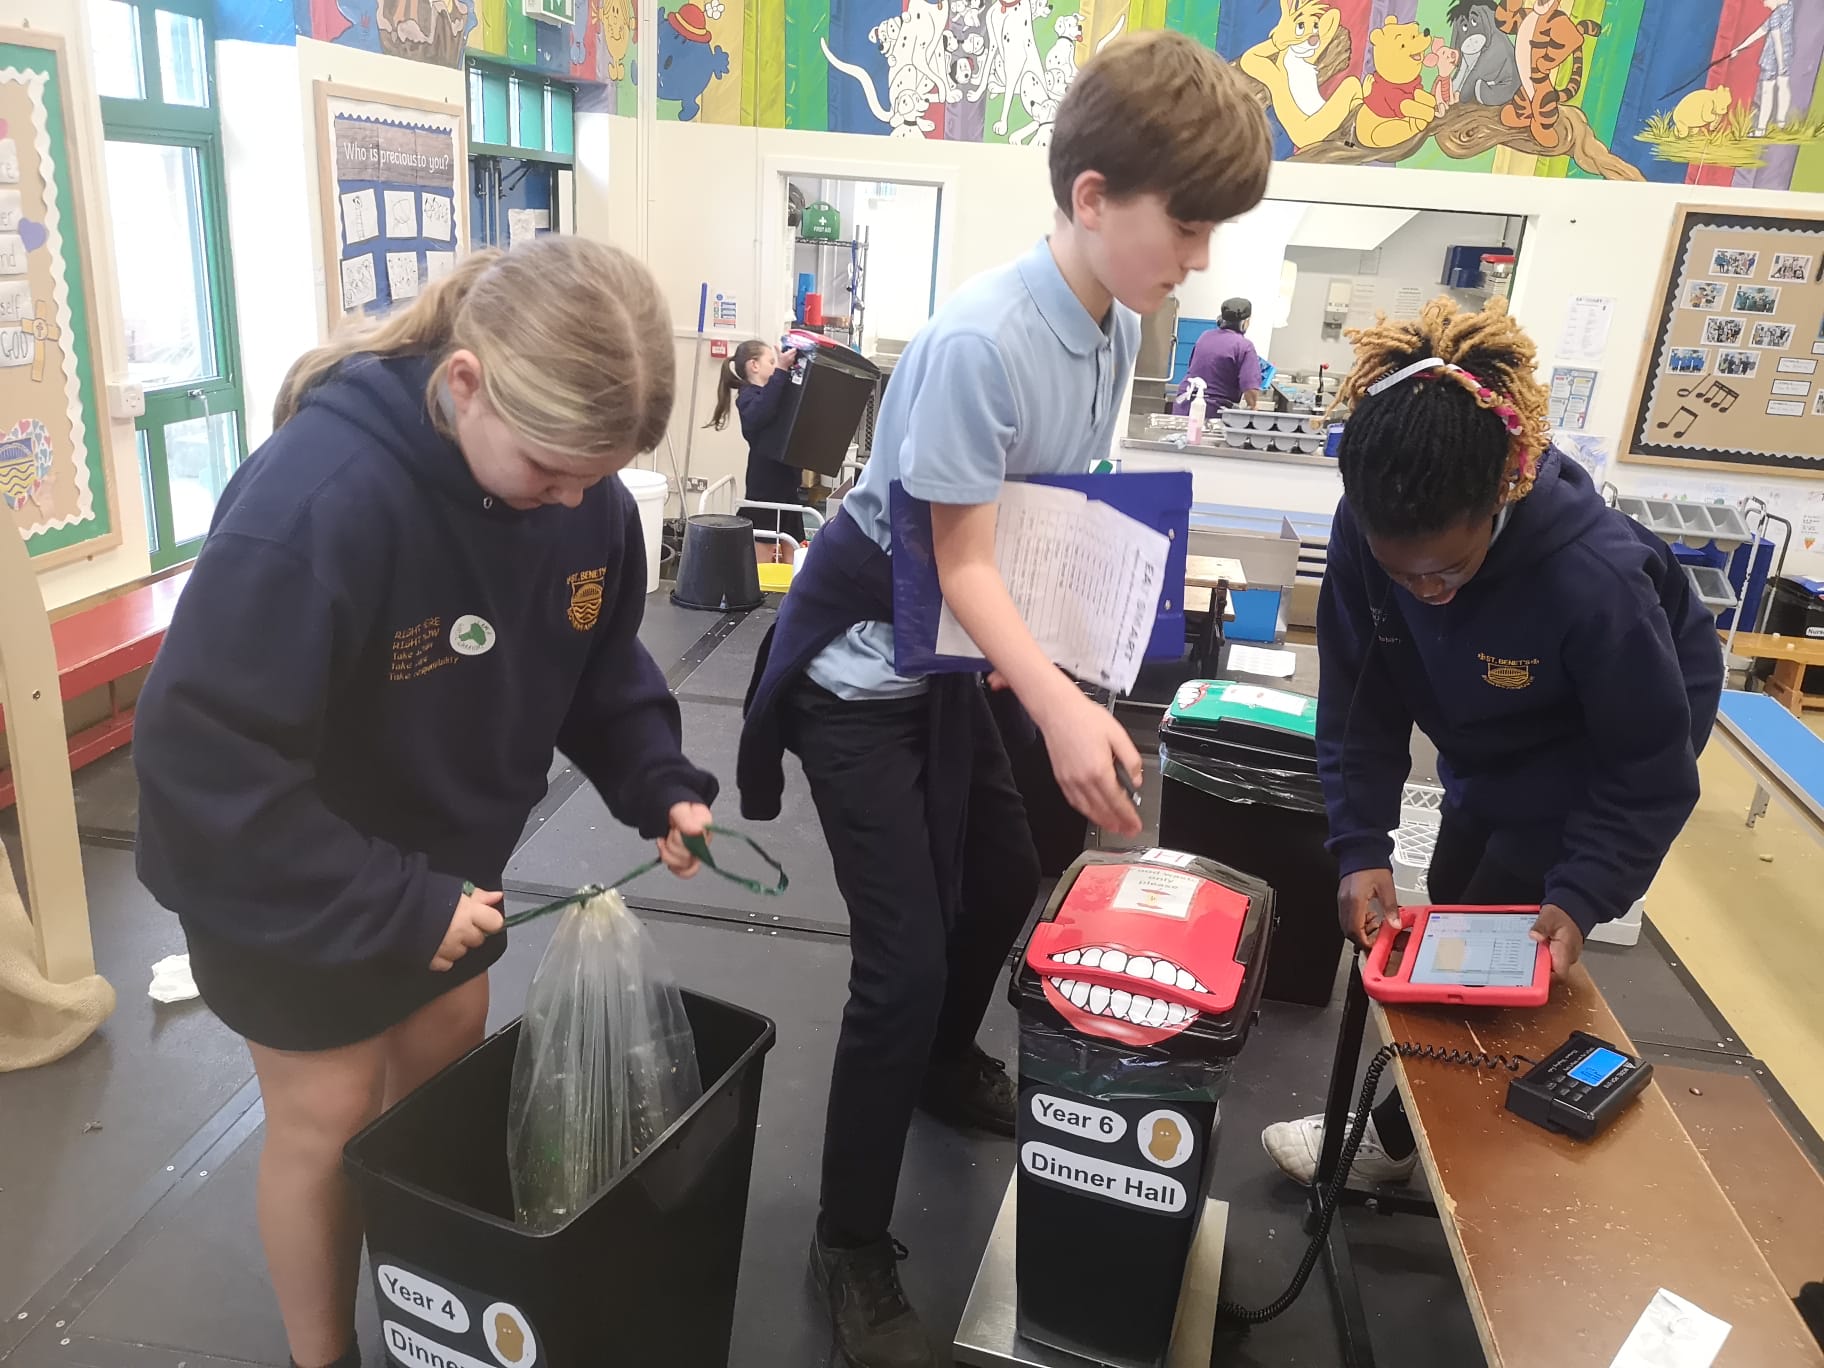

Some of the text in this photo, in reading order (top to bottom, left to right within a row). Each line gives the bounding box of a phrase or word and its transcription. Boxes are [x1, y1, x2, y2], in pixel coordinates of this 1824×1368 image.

[344, 143, 449, 173] Who is precious to you?
[1038, 1099, 1114, 1135] Year 6
[1031, 1151, 1175, 1205] Dinner Hall
[384, 1272, 456, 1320] Year 4
